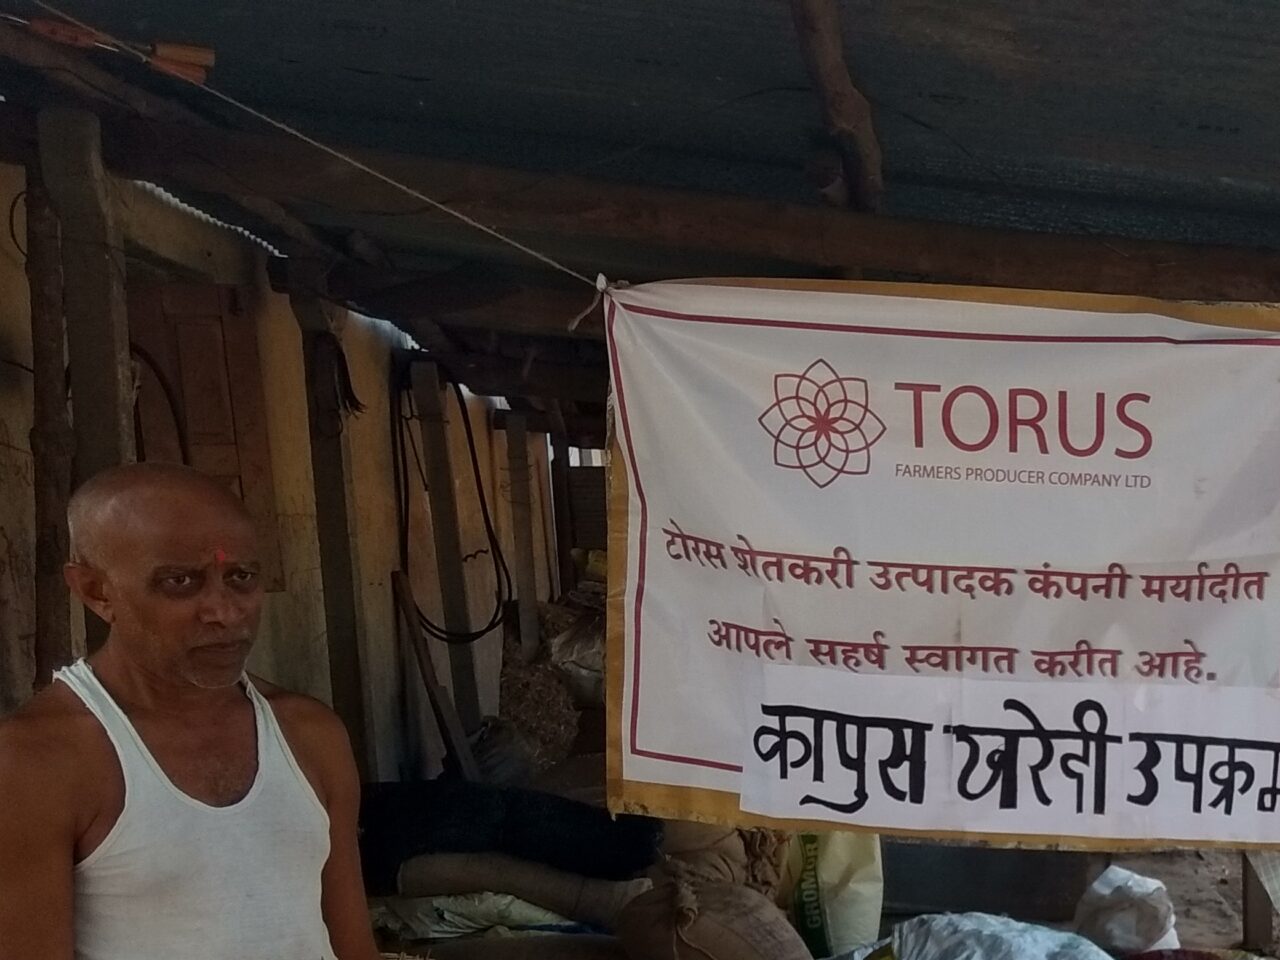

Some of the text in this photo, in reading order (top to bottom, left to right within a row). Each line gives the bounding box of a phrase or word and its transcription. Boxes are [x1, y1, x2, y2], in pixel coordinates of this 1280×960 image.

[894, 382, 1153, 459] TORUS
[895, 464, 1151, 488] FARMERS PRODUCER COMPANY LTD
[662, 518, 1270, 603] टोरस शेतकरी उत्पादक कंपनी मर्यादीत
[707, 618, 1217, 684] आपले सहर्ष स्वागत करीत आहे.
[753, 703, 934, 814] कापुस
[943, 699, 1123, 815] खरेदी
